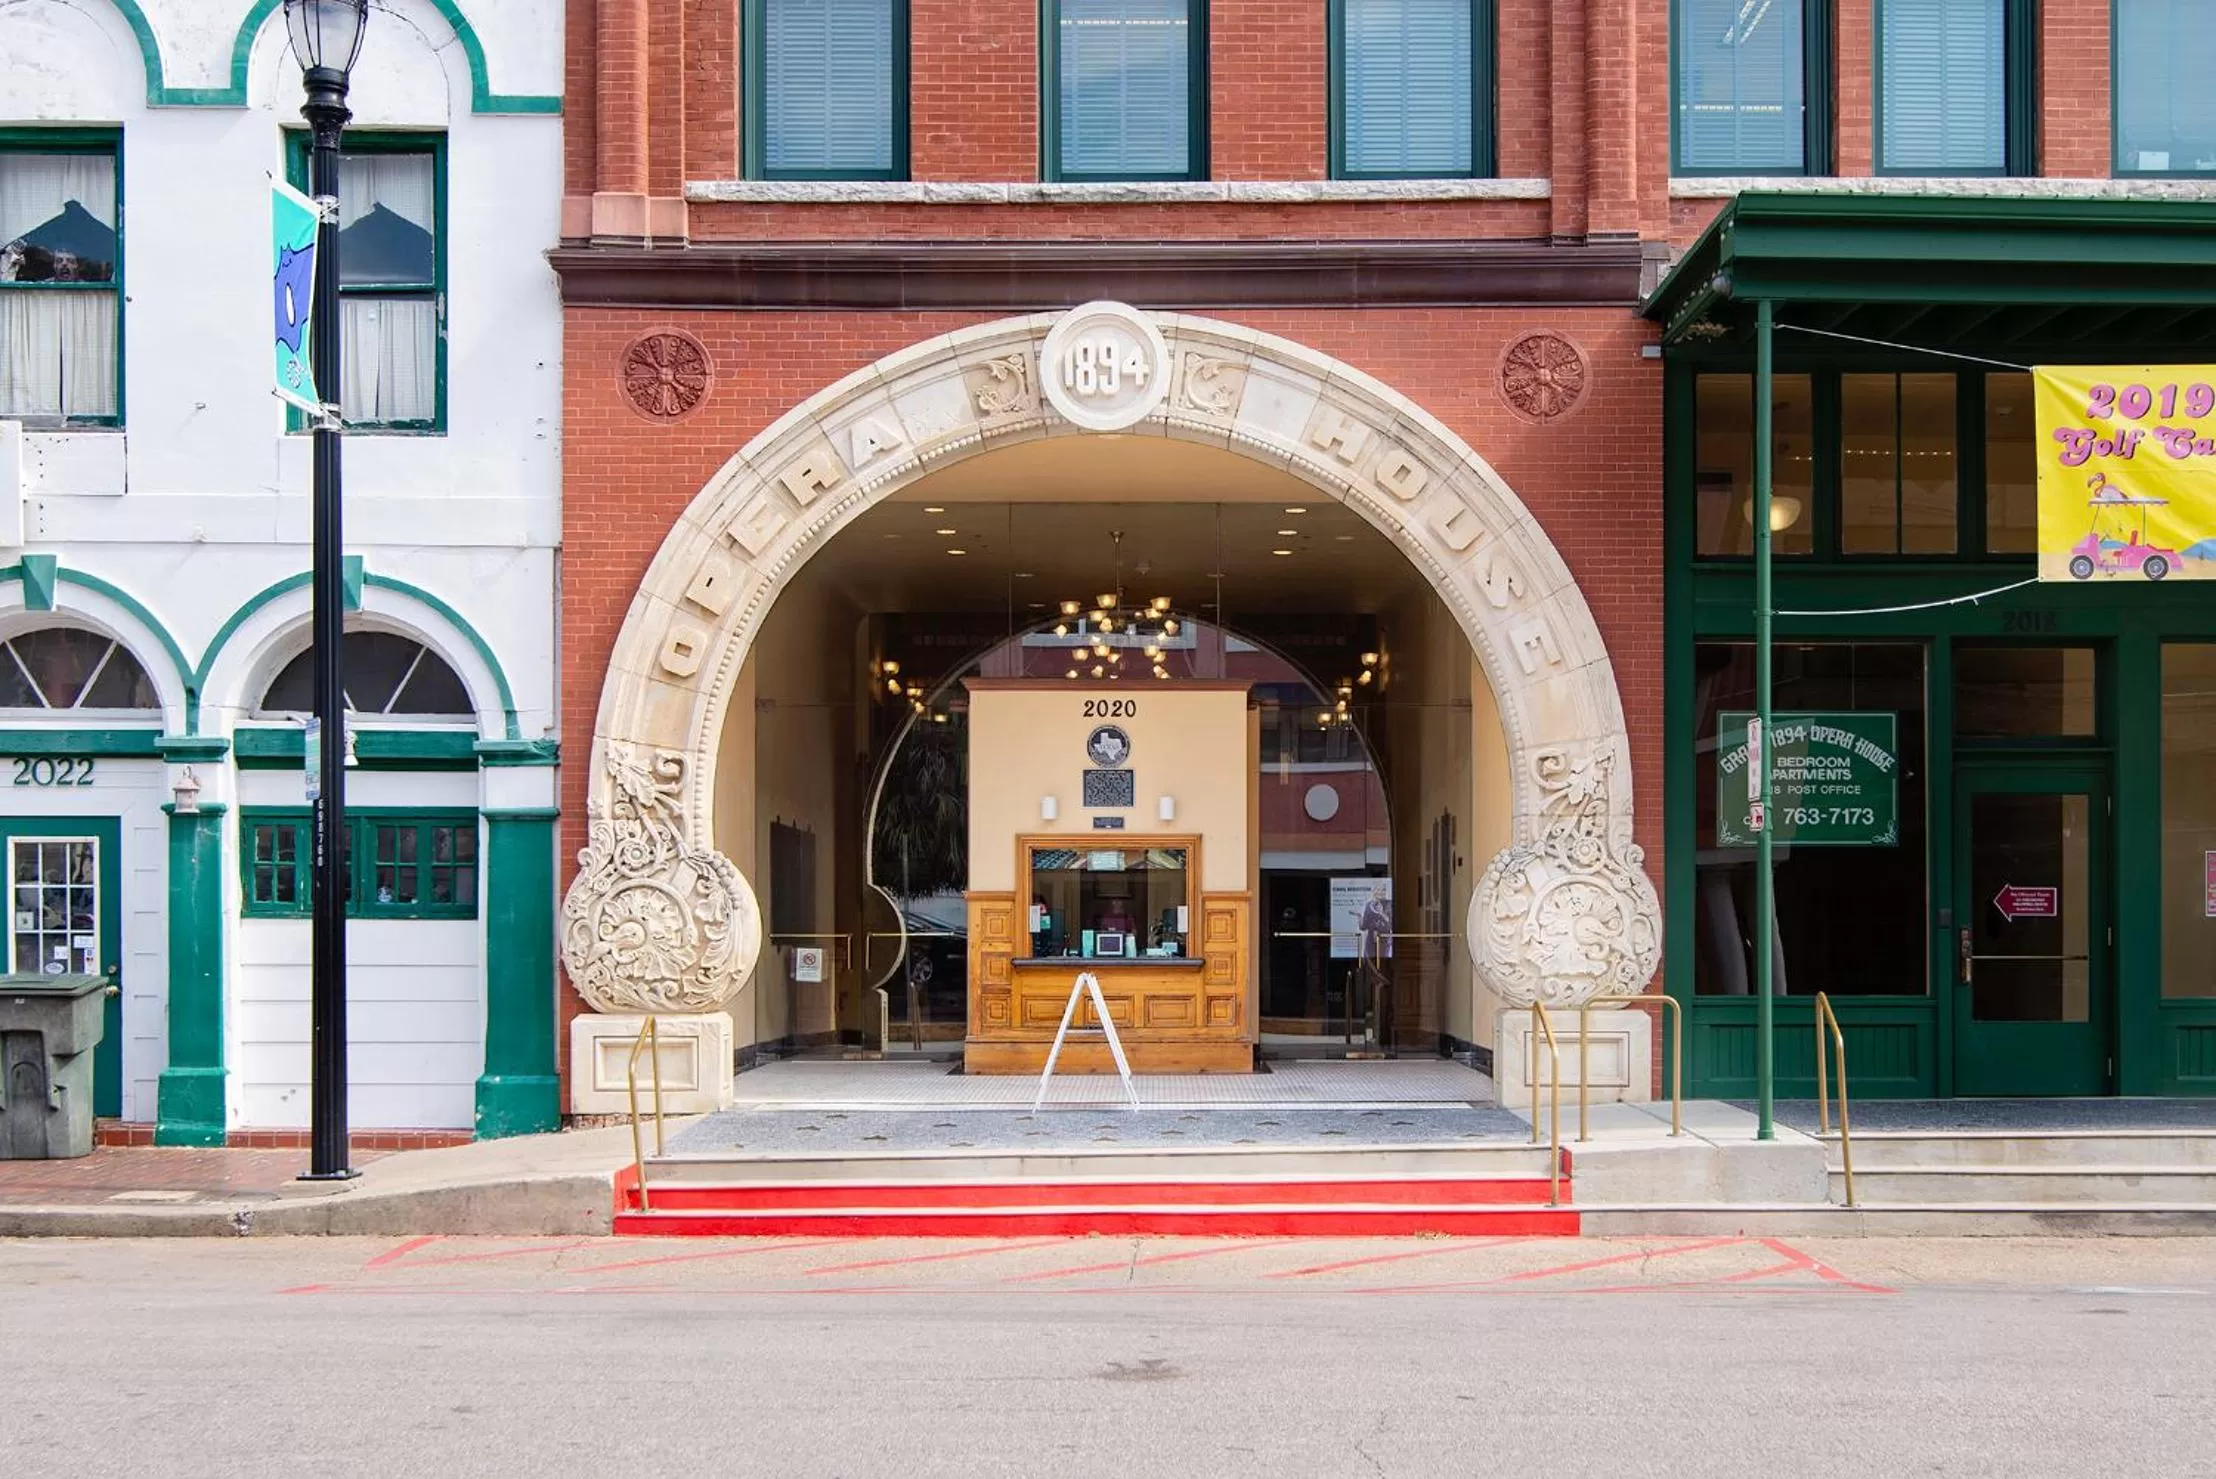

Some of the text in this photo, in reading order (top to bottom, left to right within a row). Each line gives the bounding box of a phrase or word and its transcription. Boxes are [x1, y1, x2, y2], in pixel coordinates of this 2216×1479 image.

[1064, 339, 1149, 396] 1894
[2086, 383, 2216, 420] 2019
[2053, 426, 2146, 467] Golf
[659, 416, 903, 677] OPERA
[1311, 413, 1561, 676] HOUSE
[1083, 699, 1137, 718] 2020
[1770, 726, 1808, 749] 1894
[1810, 725, 1856, 750] OPERA
[1854, 737, 1895, 773] HOUSE
[1777, 756, 1850, 768] BEDROOM
[13, 757, 95, 787] 2022
[1788, 784, 1817, 795] POST
[1820, 784, 1862, 795] OFFICE
[1783, 807, 1875, 825] 763-7173
